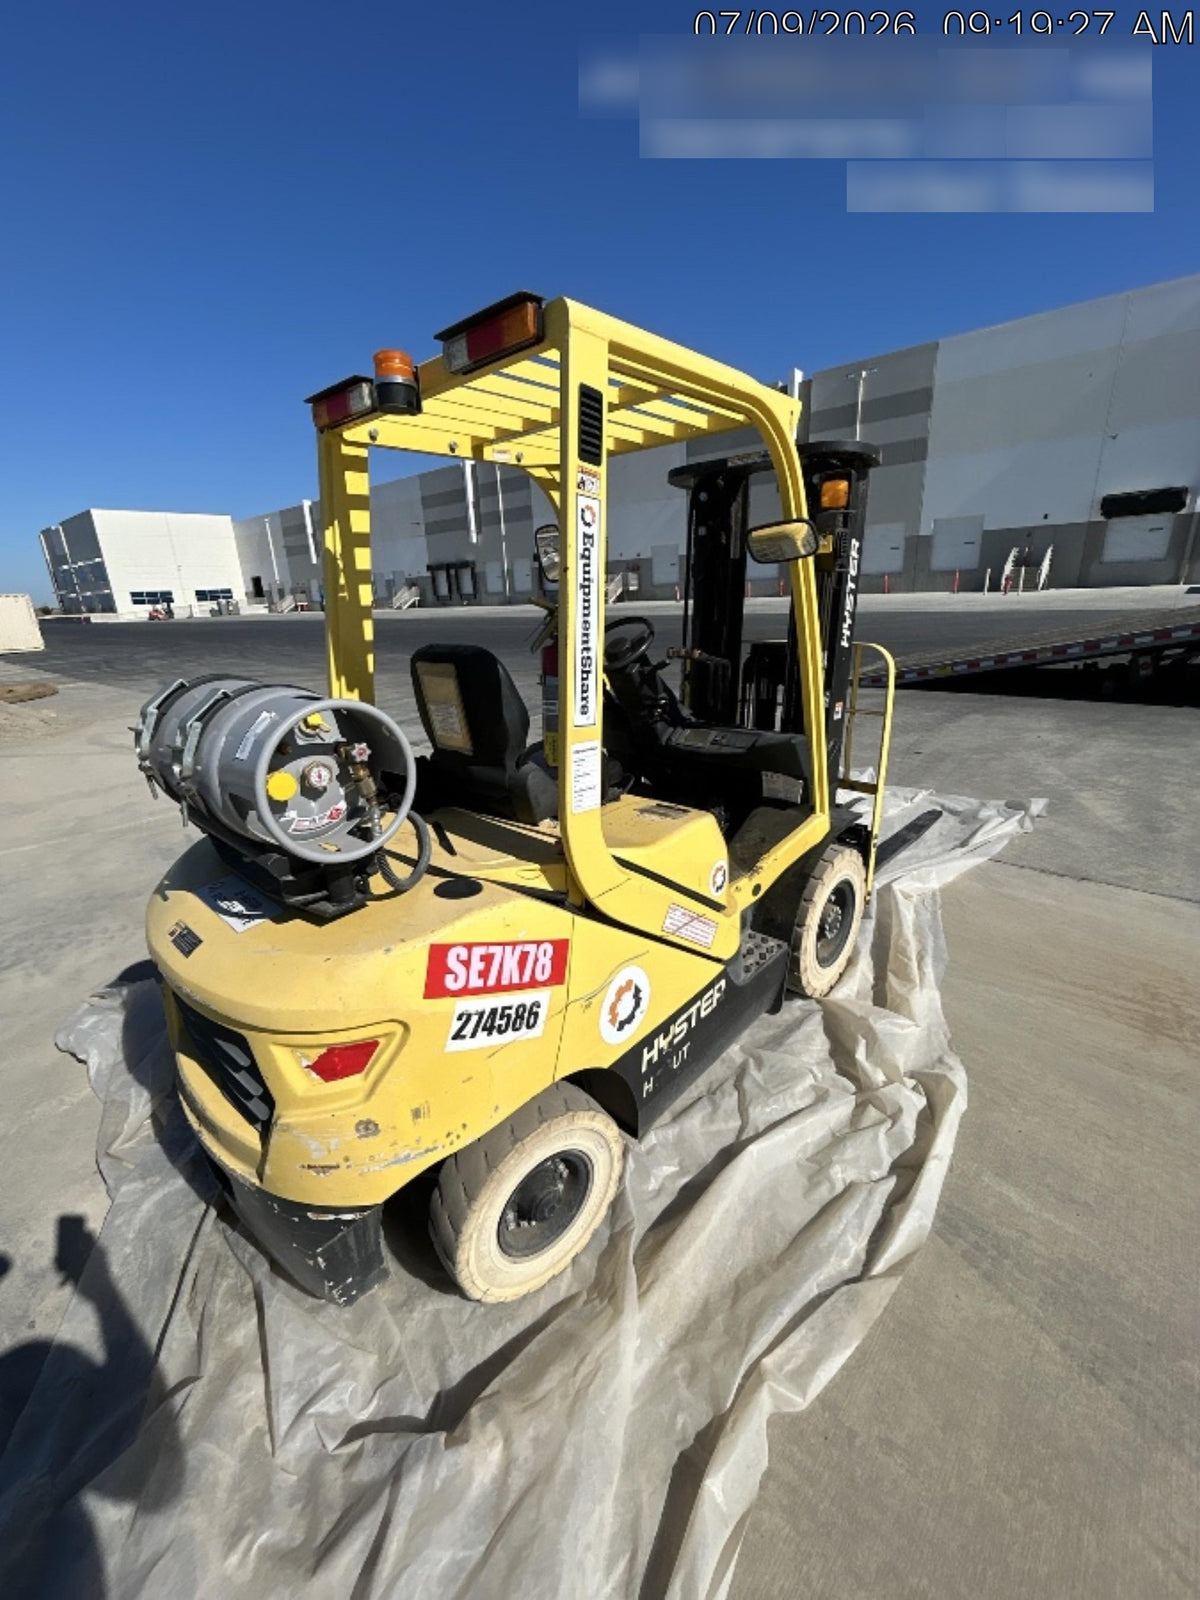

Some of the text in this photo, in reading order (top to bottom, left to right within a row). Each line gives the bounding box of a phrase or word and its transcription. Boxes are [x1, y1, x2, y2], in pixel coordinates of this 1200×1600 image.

[579, 532, 595, 716] EquipmentShare
[840, 538, 860, 648] HYSTER
[444, 942, 554, 991] SE7K78
[451, 1000, 542, 1041] 274586
[641, 978, 727, 1075] HYSTER
